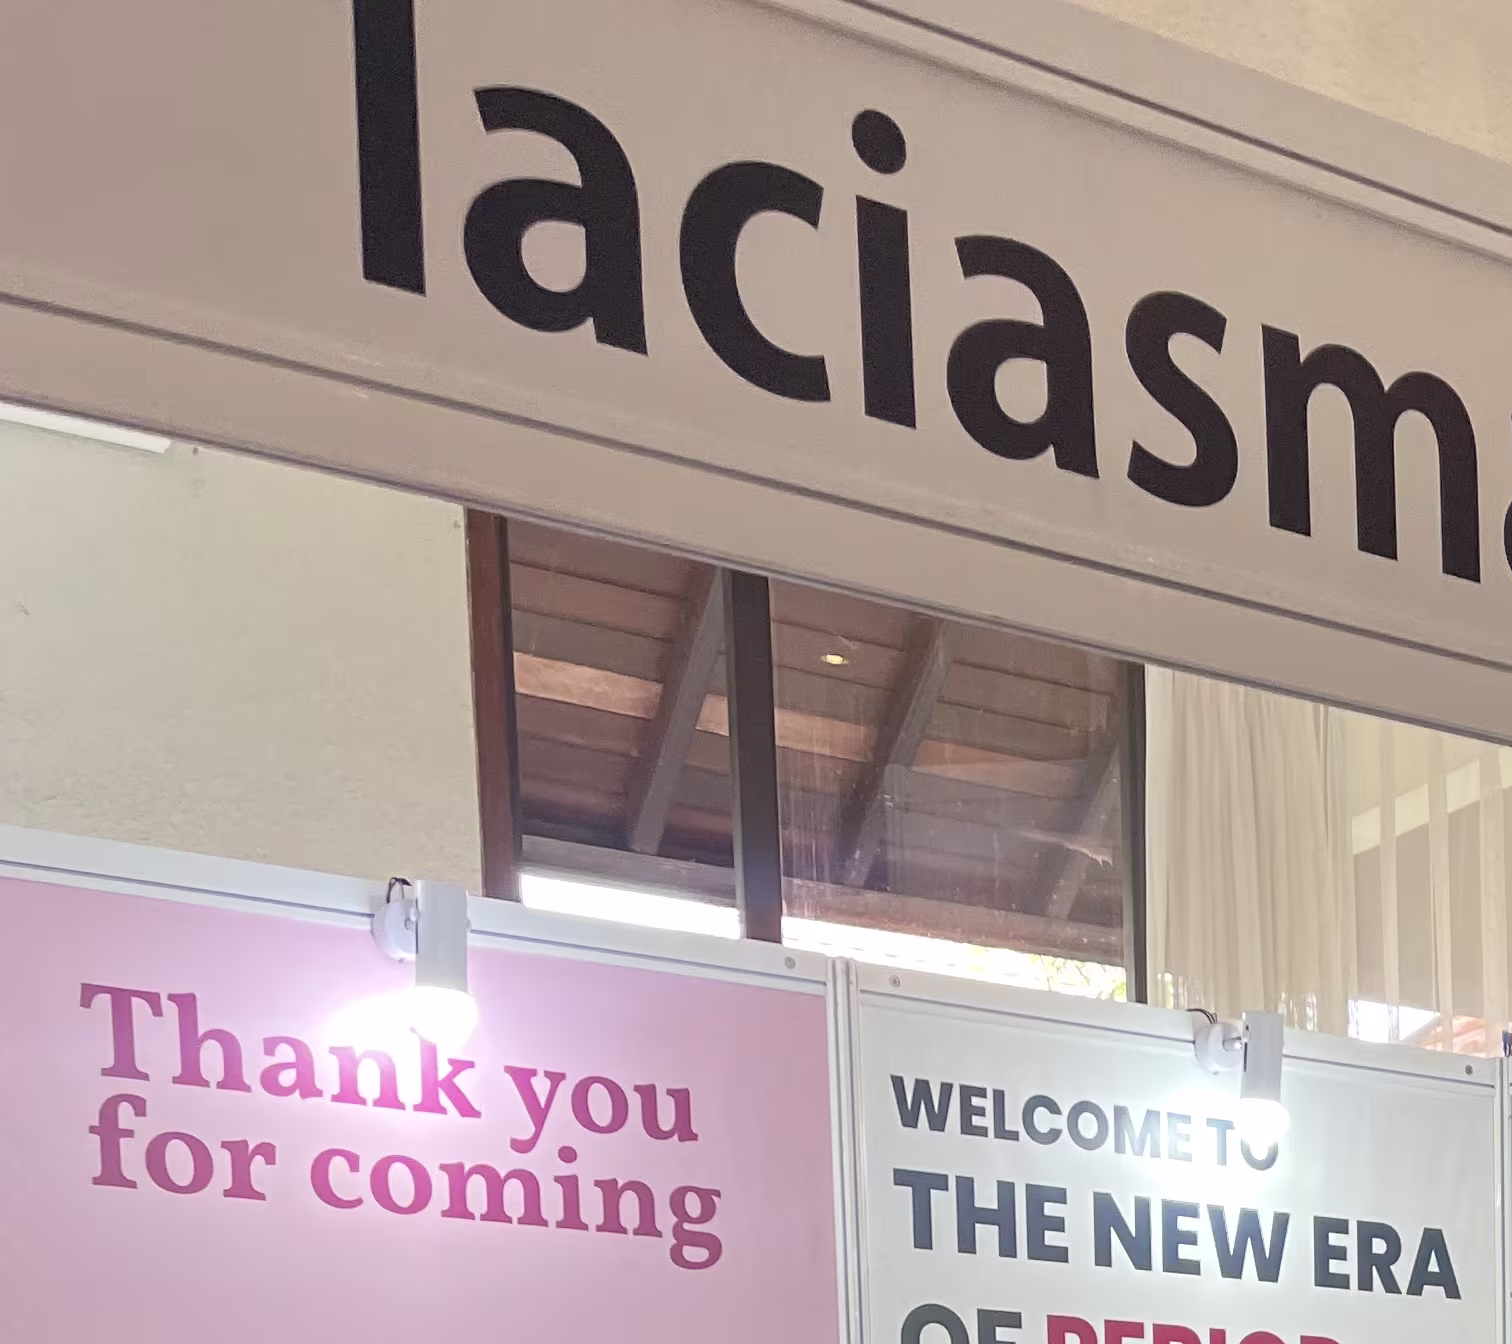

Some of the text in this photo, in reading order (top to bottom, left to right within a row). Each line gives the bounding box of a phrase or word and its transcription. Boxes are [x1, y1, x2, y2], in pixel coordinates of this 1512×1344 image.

[79, 981, 699, 1155] Thank you
[890, 1074, 1280, 1171] WELCOME TO
[89, 1092, 724, 1271] for coming
[893, 1168, 1462, 1301] THE NEW ERA
